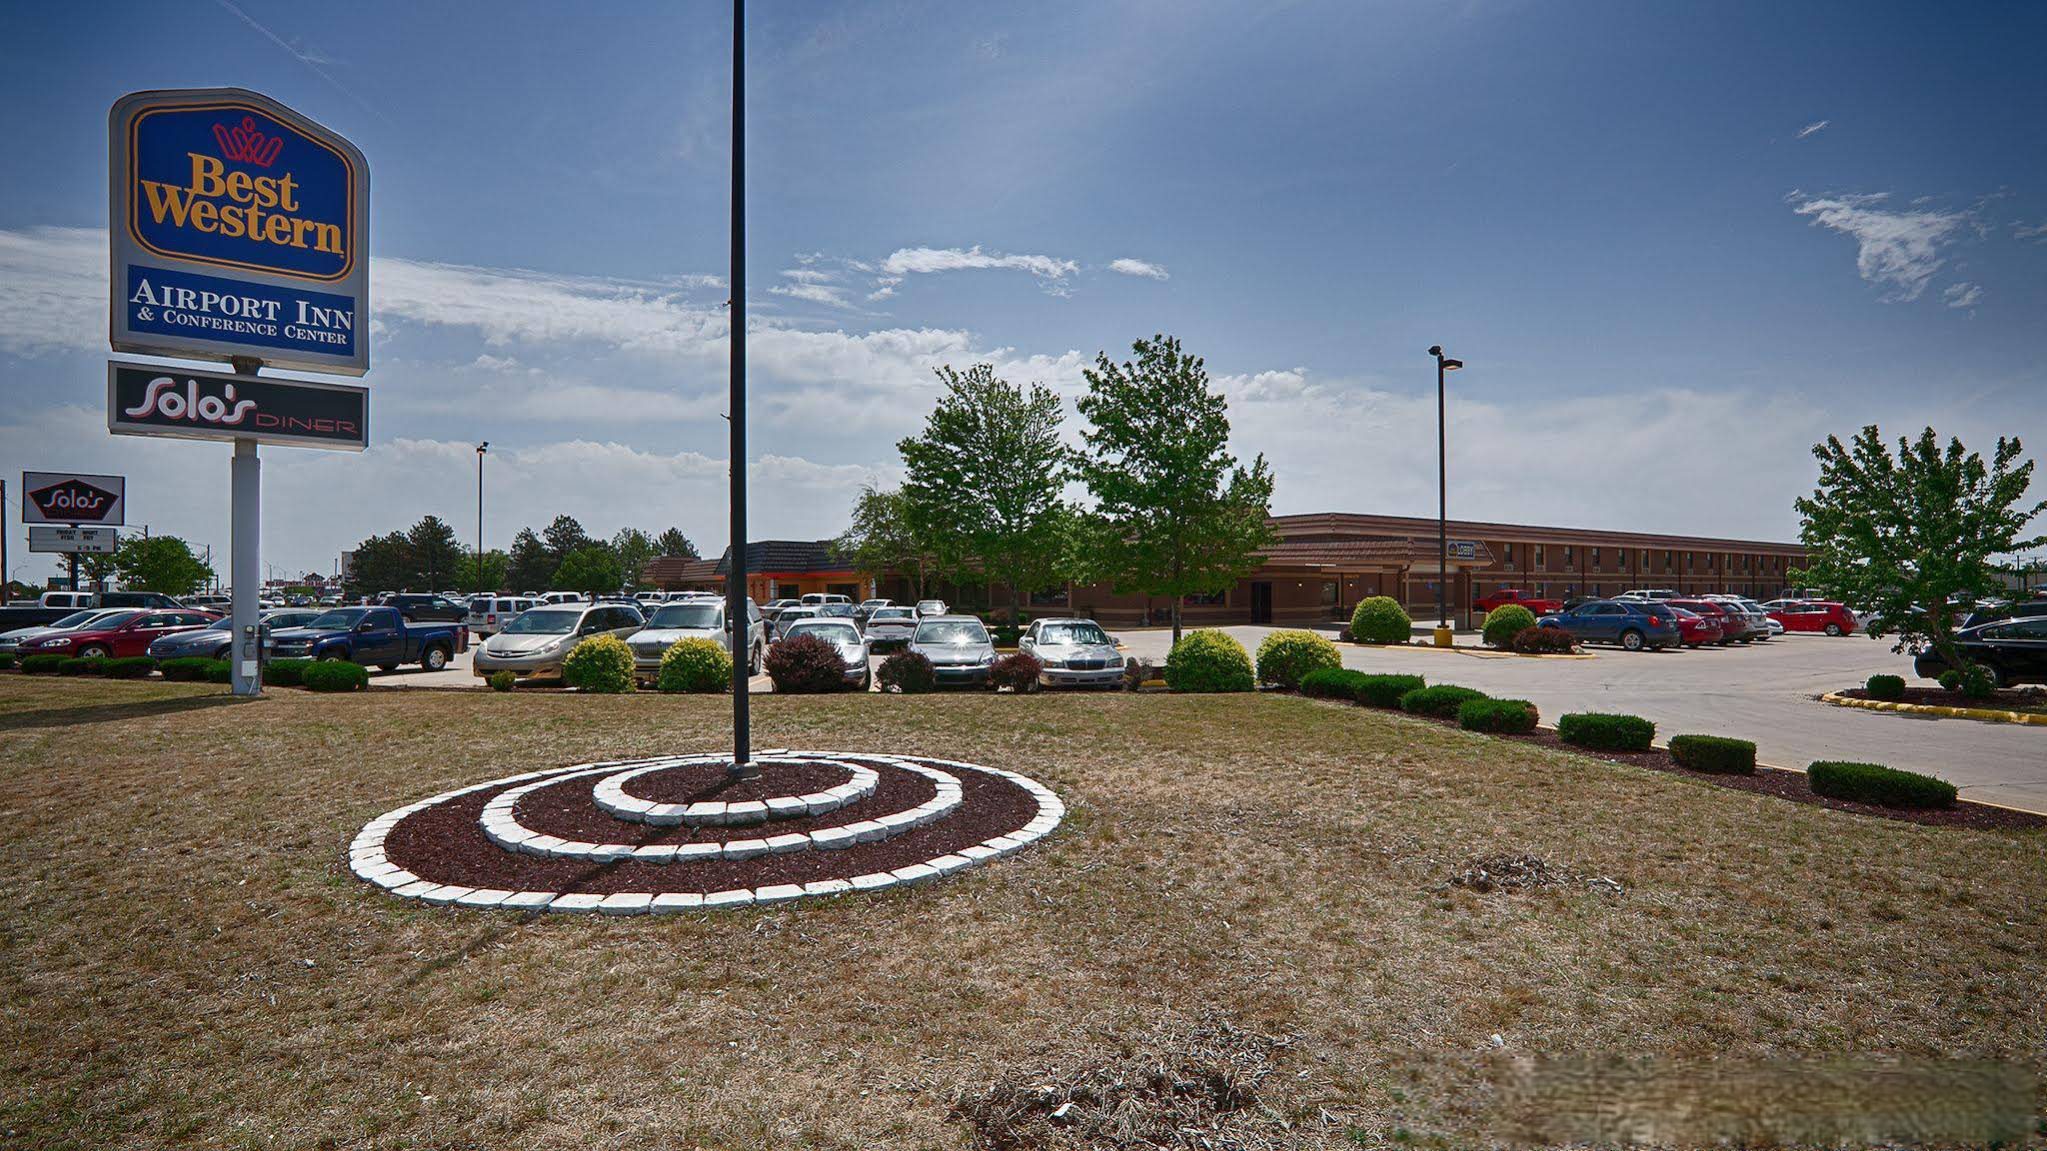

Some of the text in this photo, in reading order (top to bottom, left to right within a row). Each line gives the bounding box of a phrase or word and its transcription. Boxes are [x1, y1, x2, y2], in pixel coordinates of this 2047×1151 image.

[188, 152, 299, 212] Best
[140, 179, 345, 254] Western
[129, 278, 354, 330] AIRPORT INN
[137, 306, 348, 345] & CONFERENCE CENTER
[125, 377, 357, 434] Solo's DINER
[43, 489, 104, 509] Solo's
